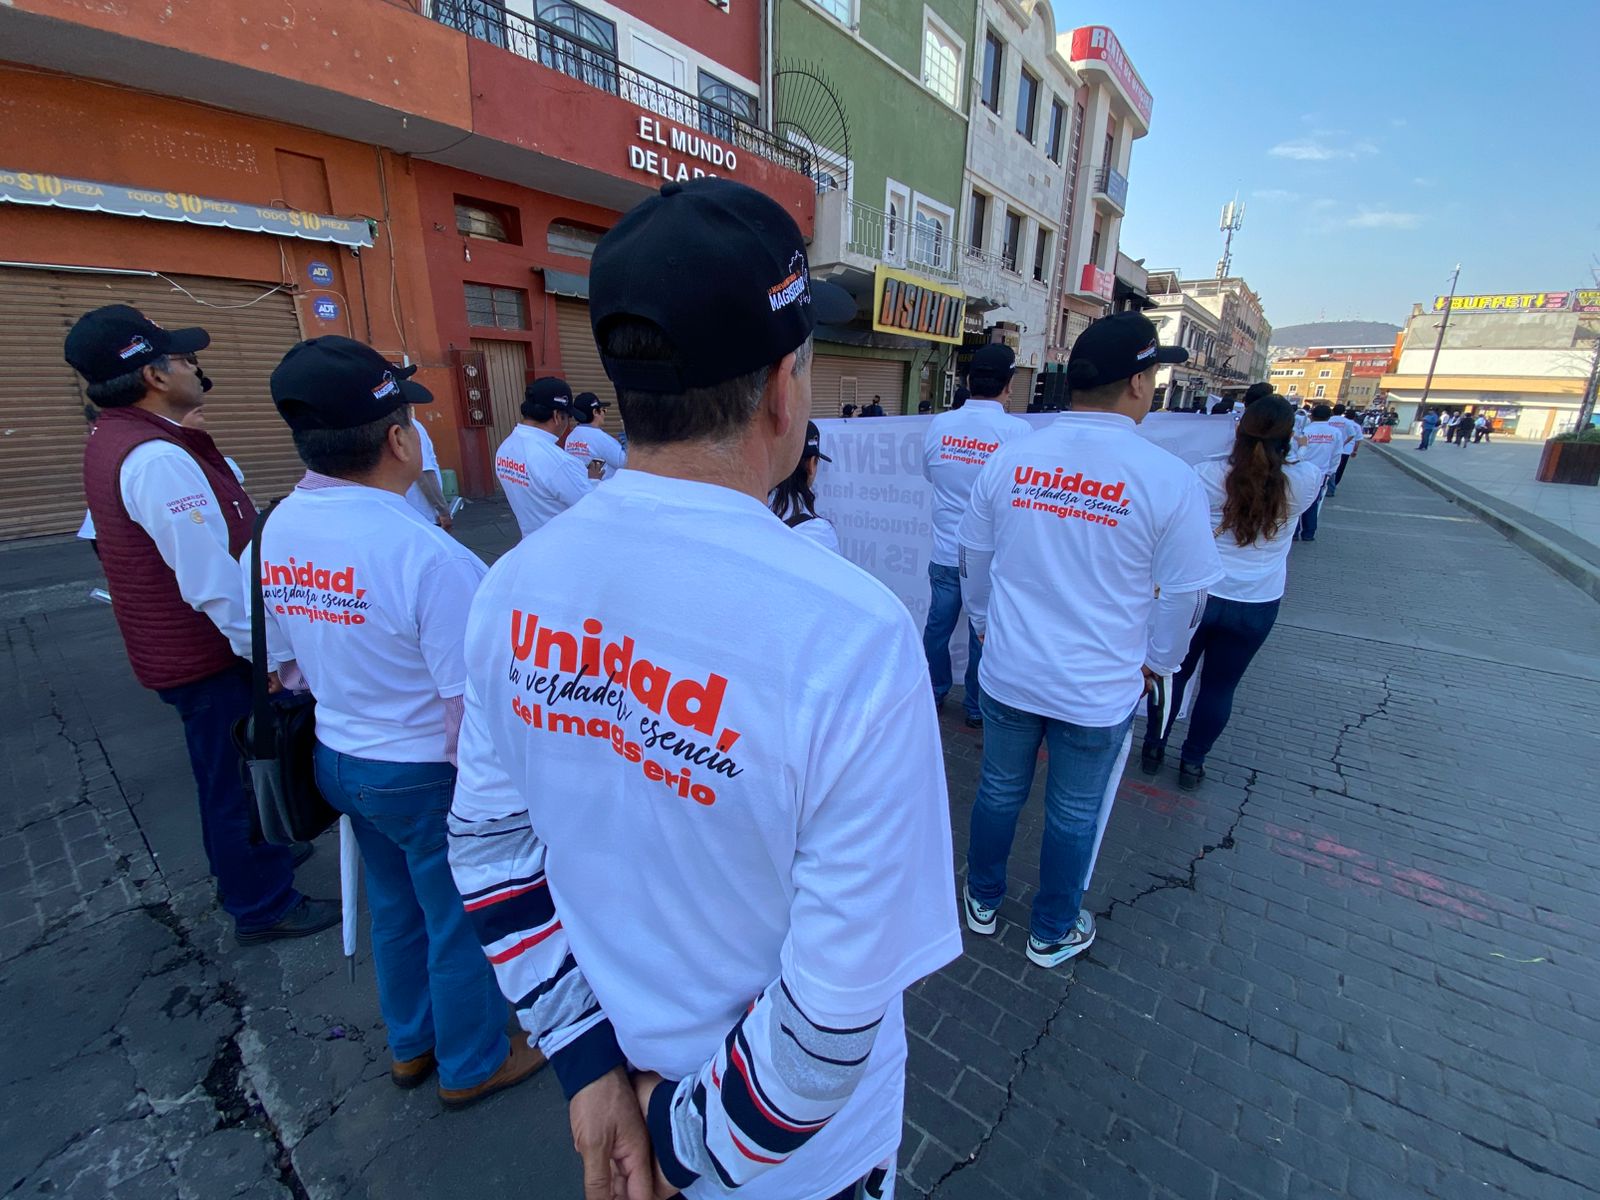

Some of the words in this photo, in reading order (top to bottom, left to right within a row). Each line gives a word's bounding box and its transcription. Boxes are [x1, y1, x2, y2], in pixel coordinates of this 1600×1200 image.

[640, 115, 667, 146] EL
[671, 127, 737, 171] MUNDO
[629, 145, 659, 175] DE
[662, 157, 689, 182] LA
[17, 172, 62, 197] $10
[63, 183, 104, 197] PIEZA
[127, 190, 163, 204] TODO
[164, 192, 202, 214] $10
[203, 200, 238, 214] PIEZA
[256, 208, 287, 222] TODO
[287, 211, 320, 231] $10
[312, 267, 328, 277] ADT
[318, 304, 334, 313] ADT
[1450, 293, 1534, 309] BUFFET
[1011, 479, 1022, 495] la
[1025, 482, 1081, 506] verdadera
[1084, 498, 1132, 516] esencia
[1014, 466, 1130, 509] Unidad,
[1011, 497, 1031, 509] del
[1033, 501, 1118, 528] magisterio
[321, 592, 373, 611] esencia
[511, 609, 741, 753] Unidad,
[512, 695, 543, 729] del
[640, 716, 744, 779] esencia
